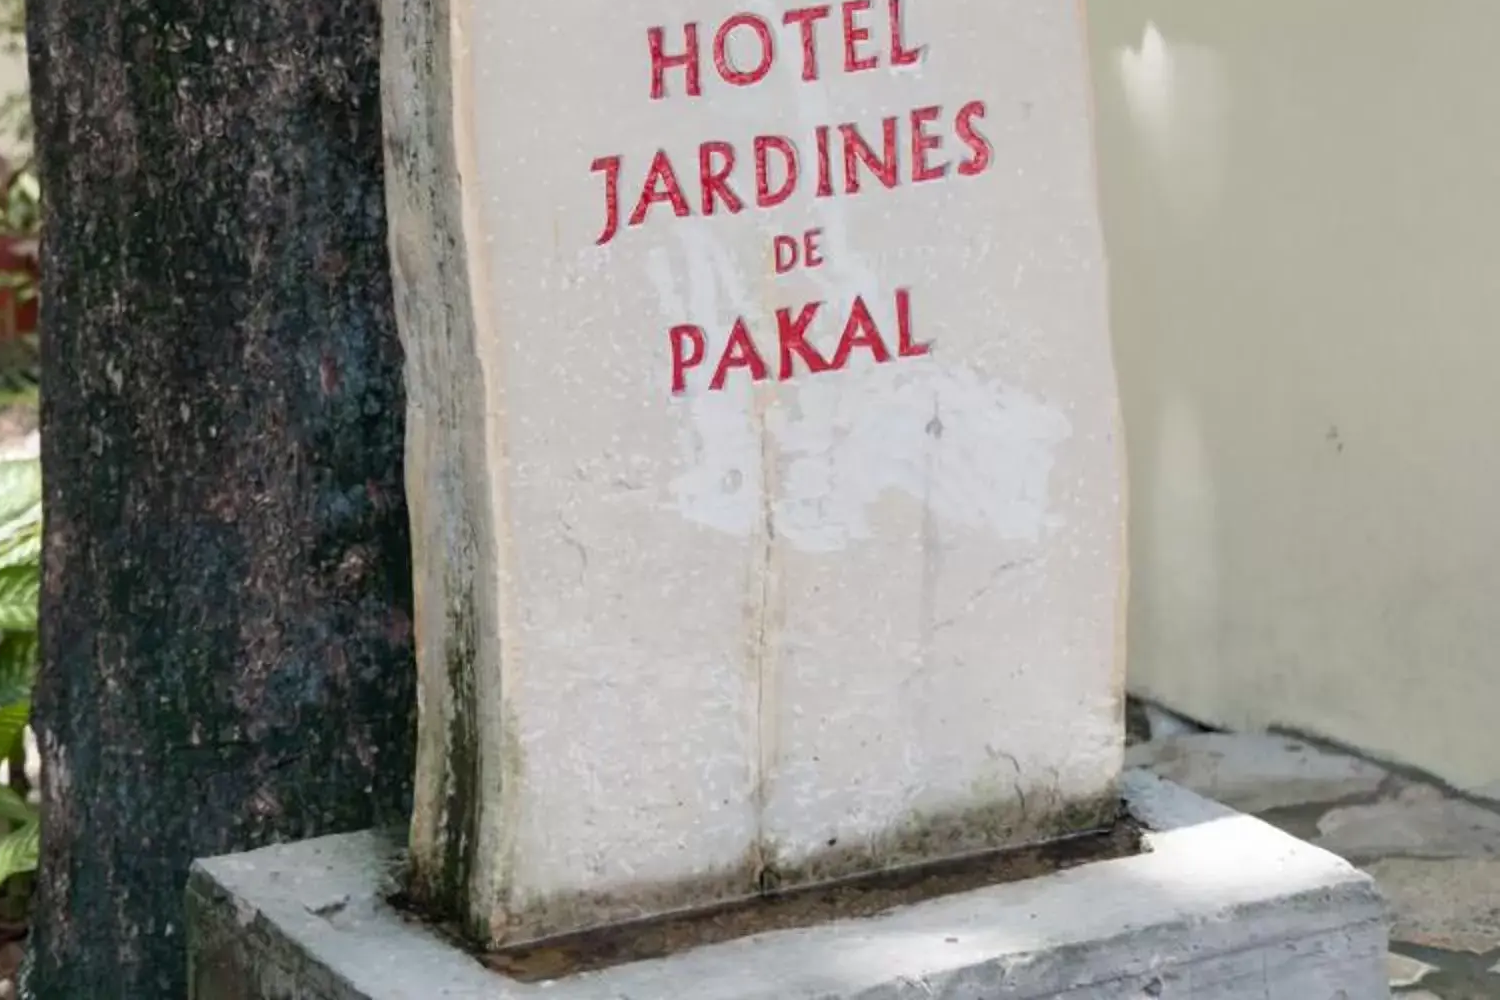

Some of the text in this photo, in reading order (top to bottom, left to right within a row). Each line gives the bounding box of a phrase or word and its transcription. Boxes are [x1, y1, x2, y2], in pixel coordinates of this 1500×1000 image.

[590, 101, 992, 246] JARDINES
[773, 228, 825, 275] DE
[668, 287, 933, 395] PAKAL
